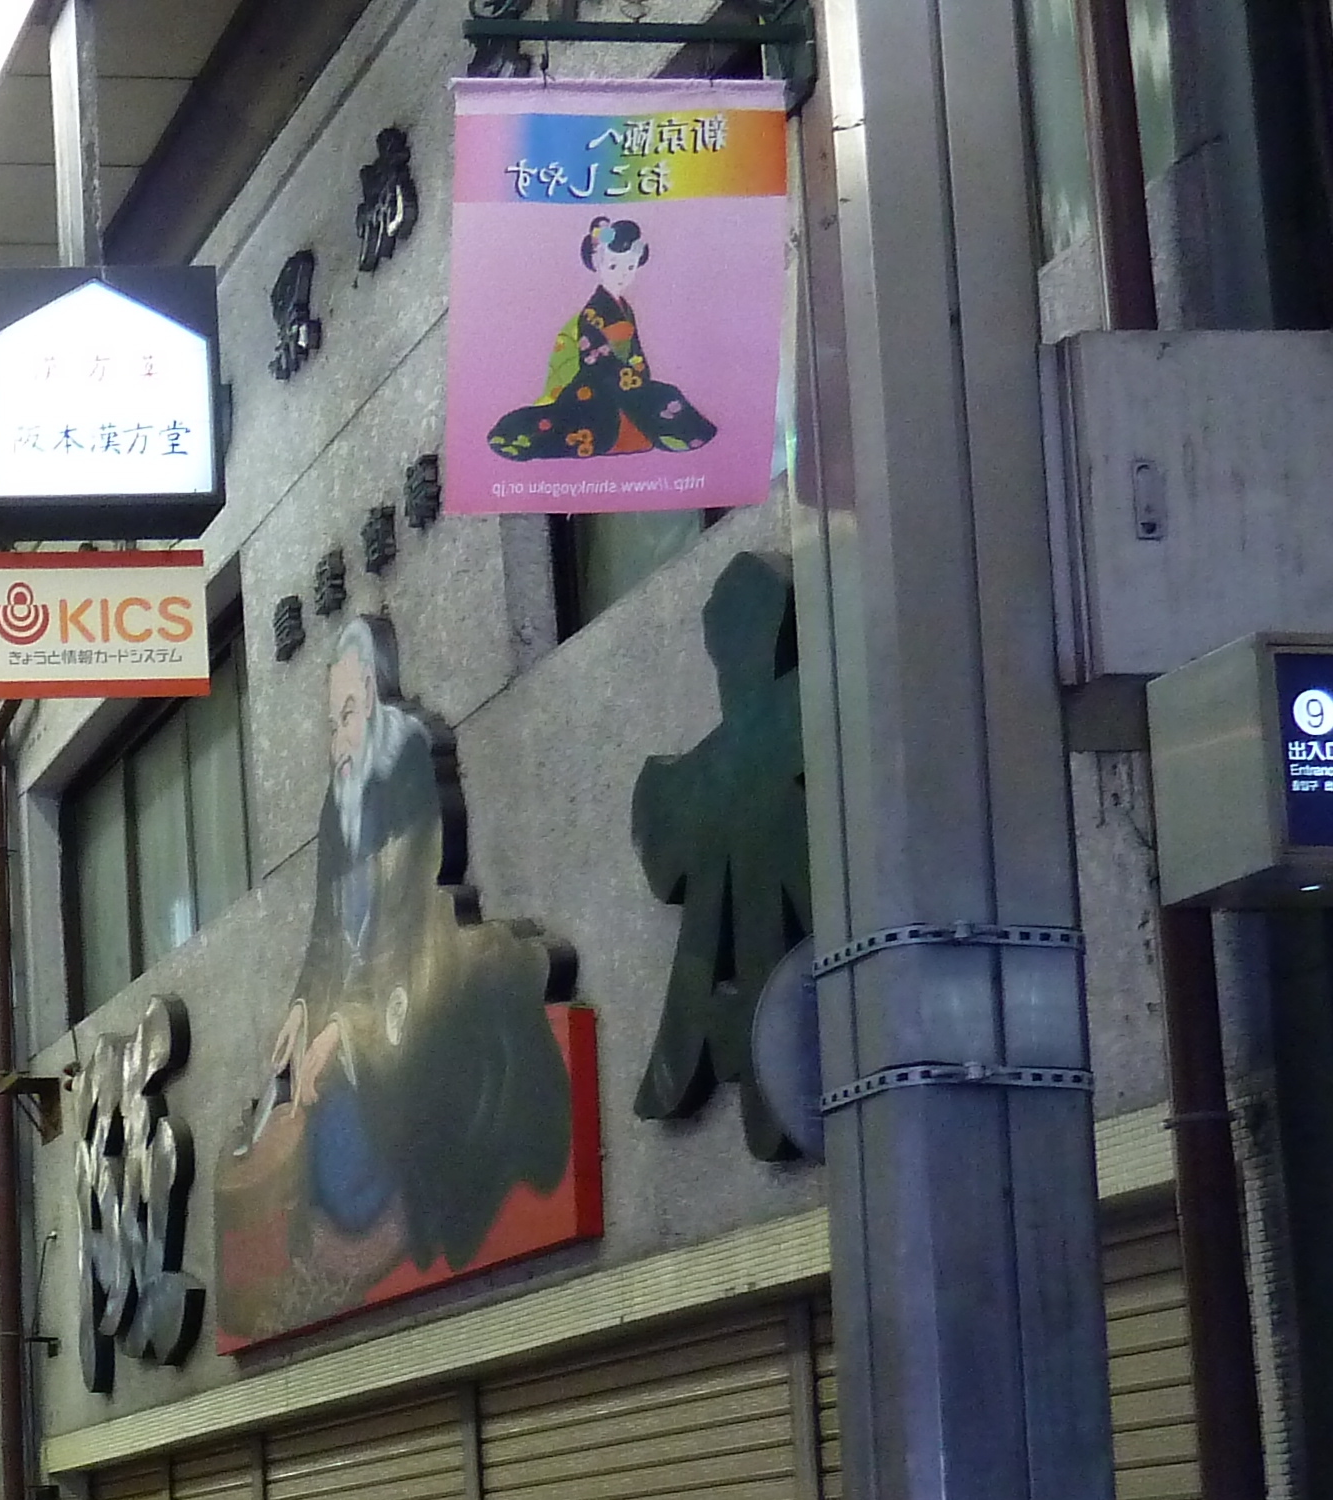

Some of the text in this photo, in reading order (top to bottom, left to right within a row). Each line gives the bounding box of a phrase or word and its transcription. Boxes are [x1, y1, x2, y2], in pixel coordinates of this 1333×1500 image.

[13, 418, 192, 457] 阪本漢方堂
[59, 595, 194, 644] KICS
[8, 647, 183, 666] きょうと情報カードシステム
[1305, 698, 1325, 729] 9
